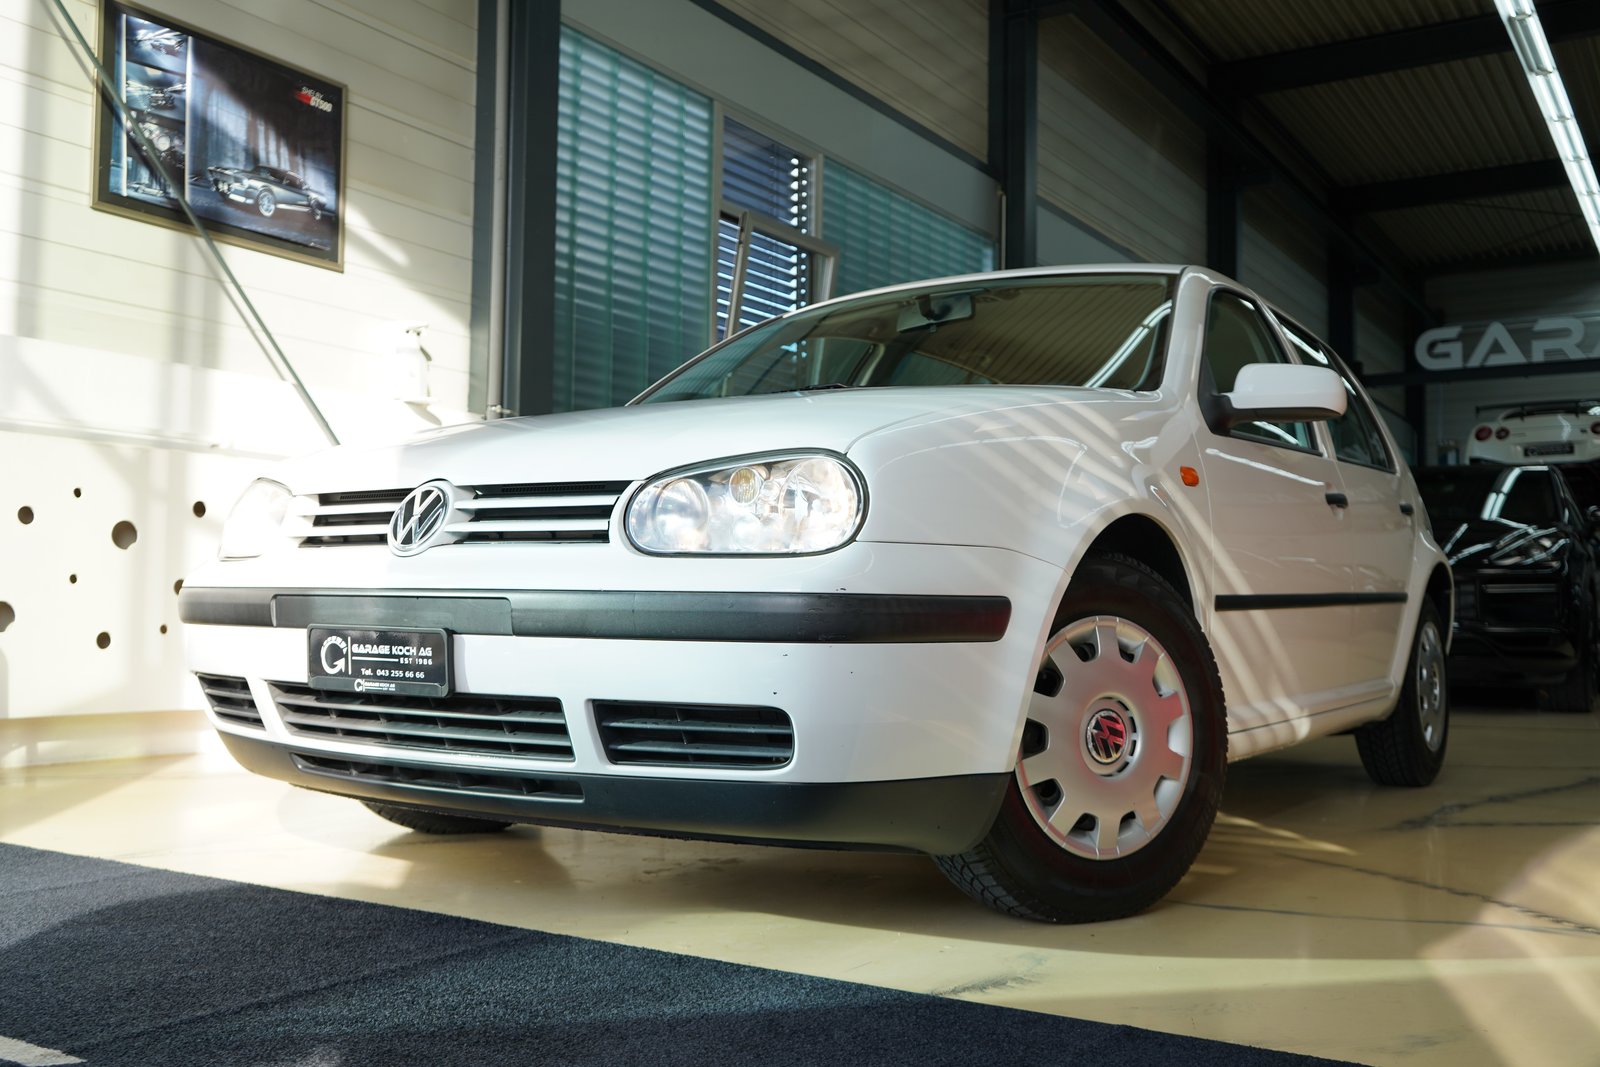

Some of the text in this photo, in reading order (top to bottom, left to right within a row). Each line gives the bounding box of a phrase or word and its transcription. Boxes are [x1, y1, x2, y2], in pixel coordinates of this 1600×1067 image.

[1415, 316, 1600, 371] GAR
[352, 643, 432, 657] GARAGE KOCH AG
[400, 657, 413, 665] EST
[361, 668, 425, 679] Tel. 043 255 66 66
